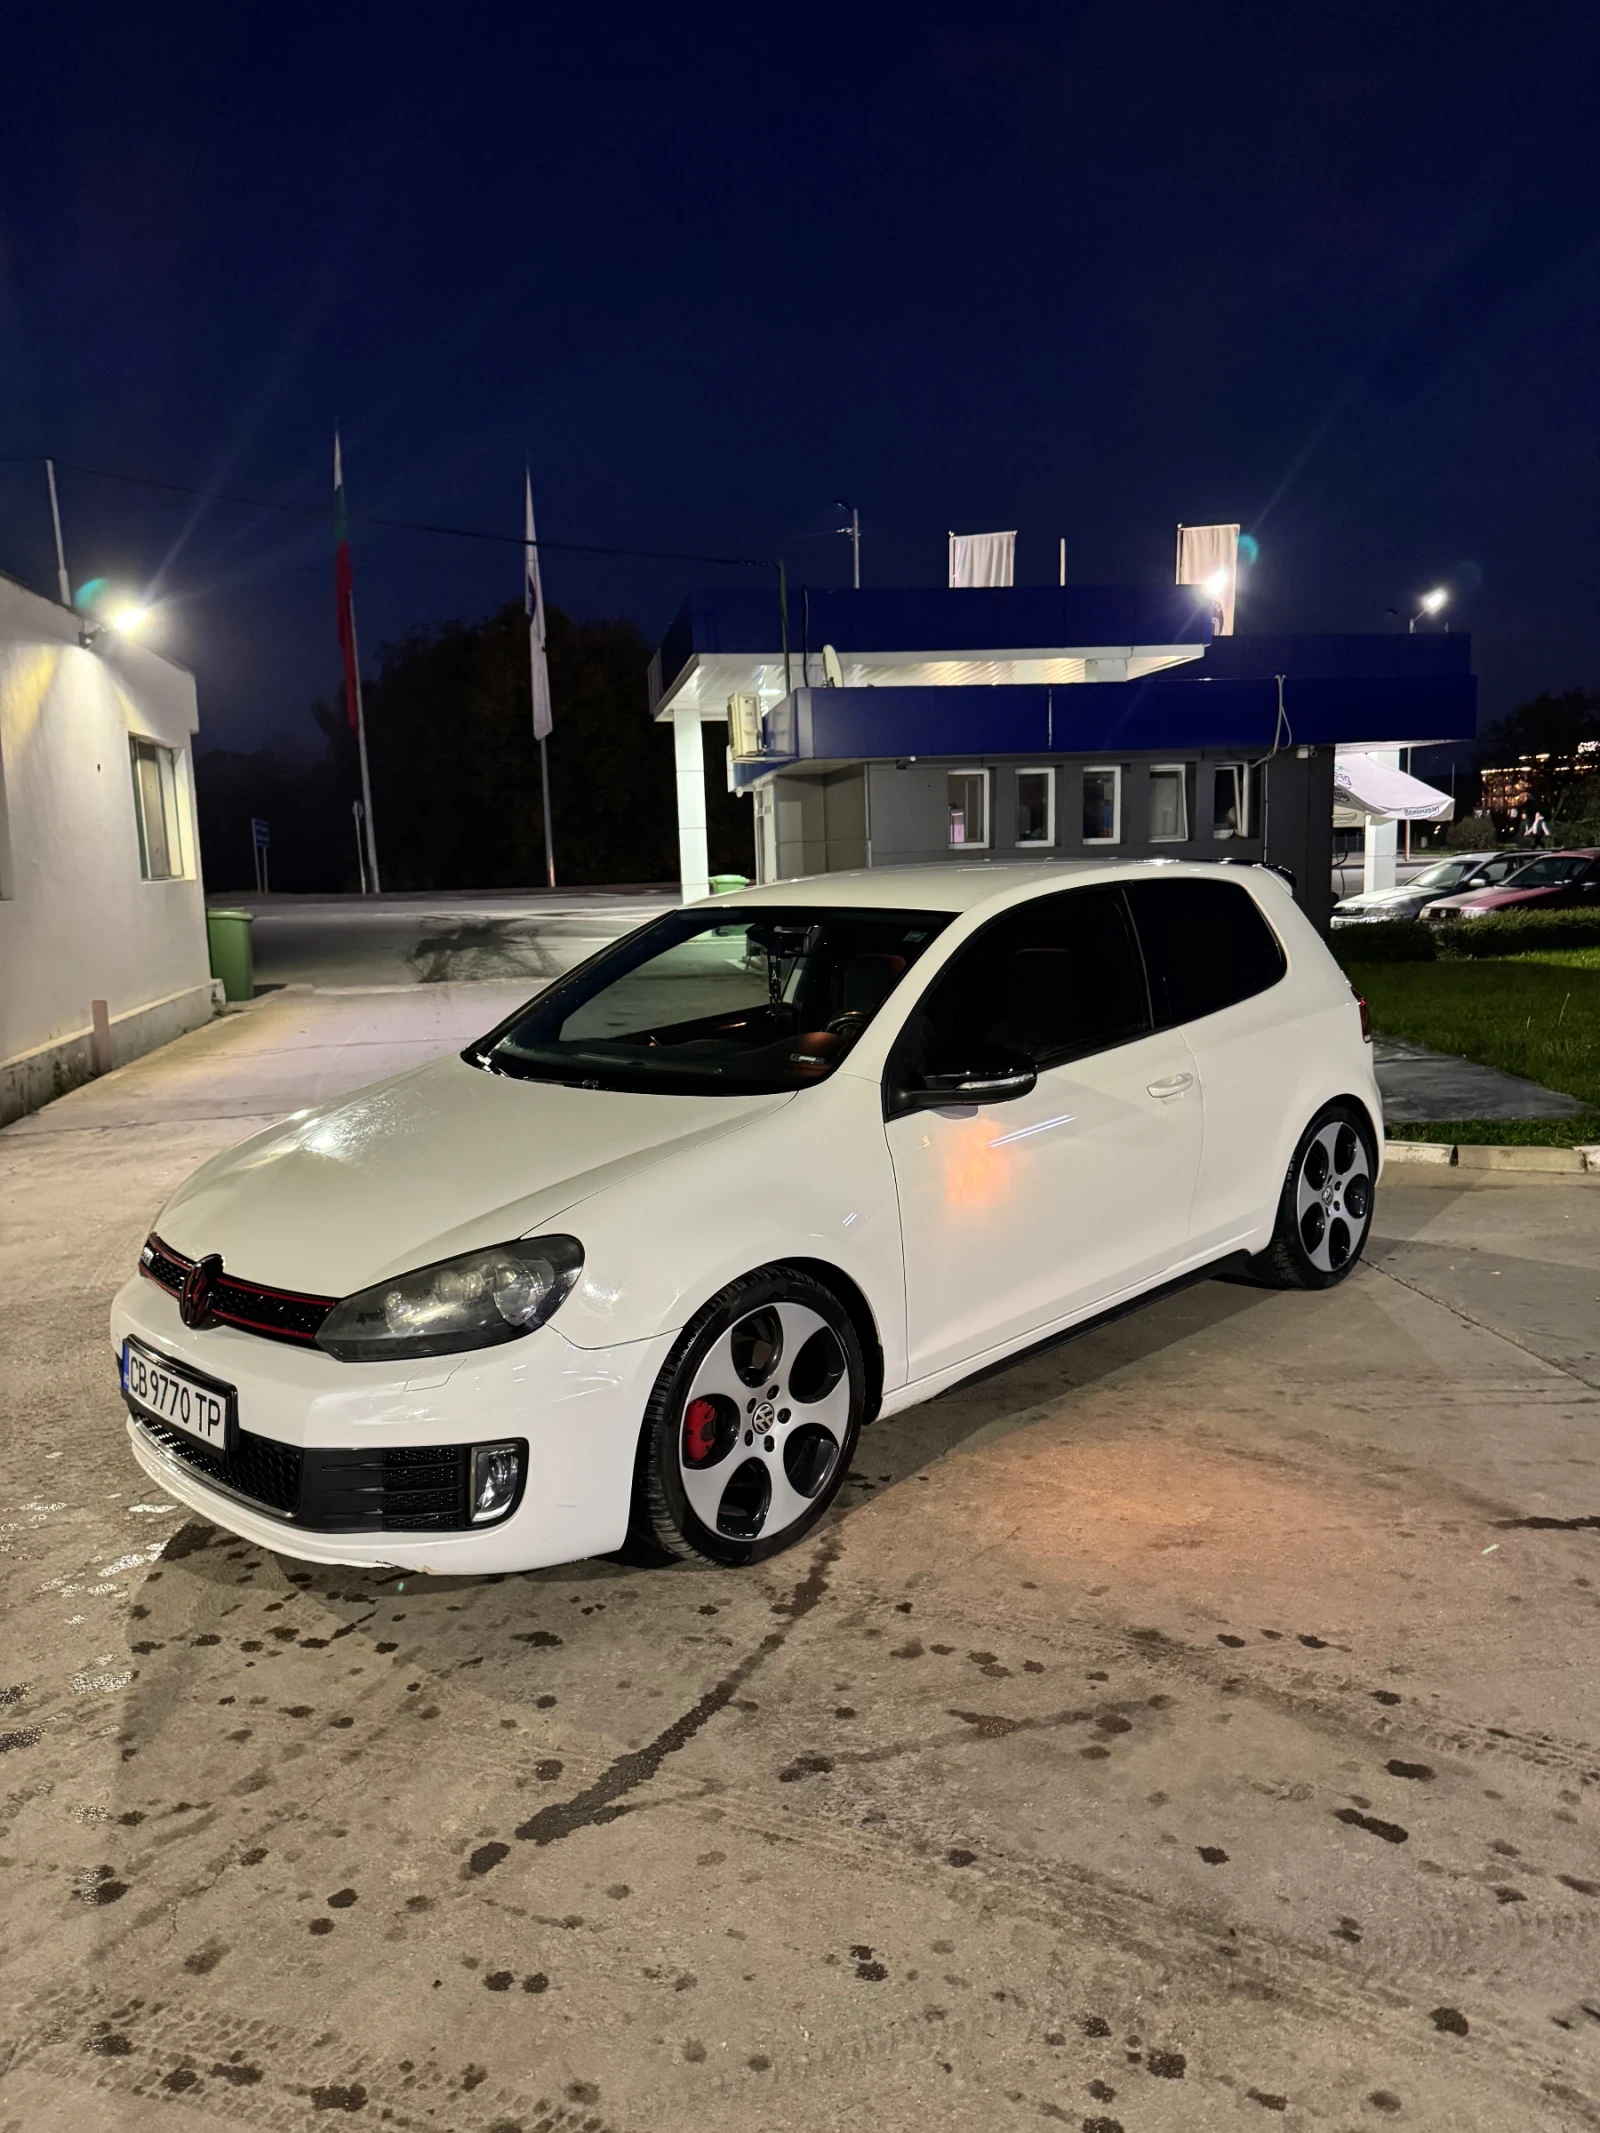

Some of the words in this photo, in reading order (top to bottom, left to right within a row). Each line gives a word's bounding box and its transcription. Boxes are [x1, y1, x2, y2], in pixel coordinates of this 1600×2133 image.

[130, 1356, 148, 1399] CB
[150, 1370, 190, 1424] 9770
[195, 1392, 221, 1437] TP
